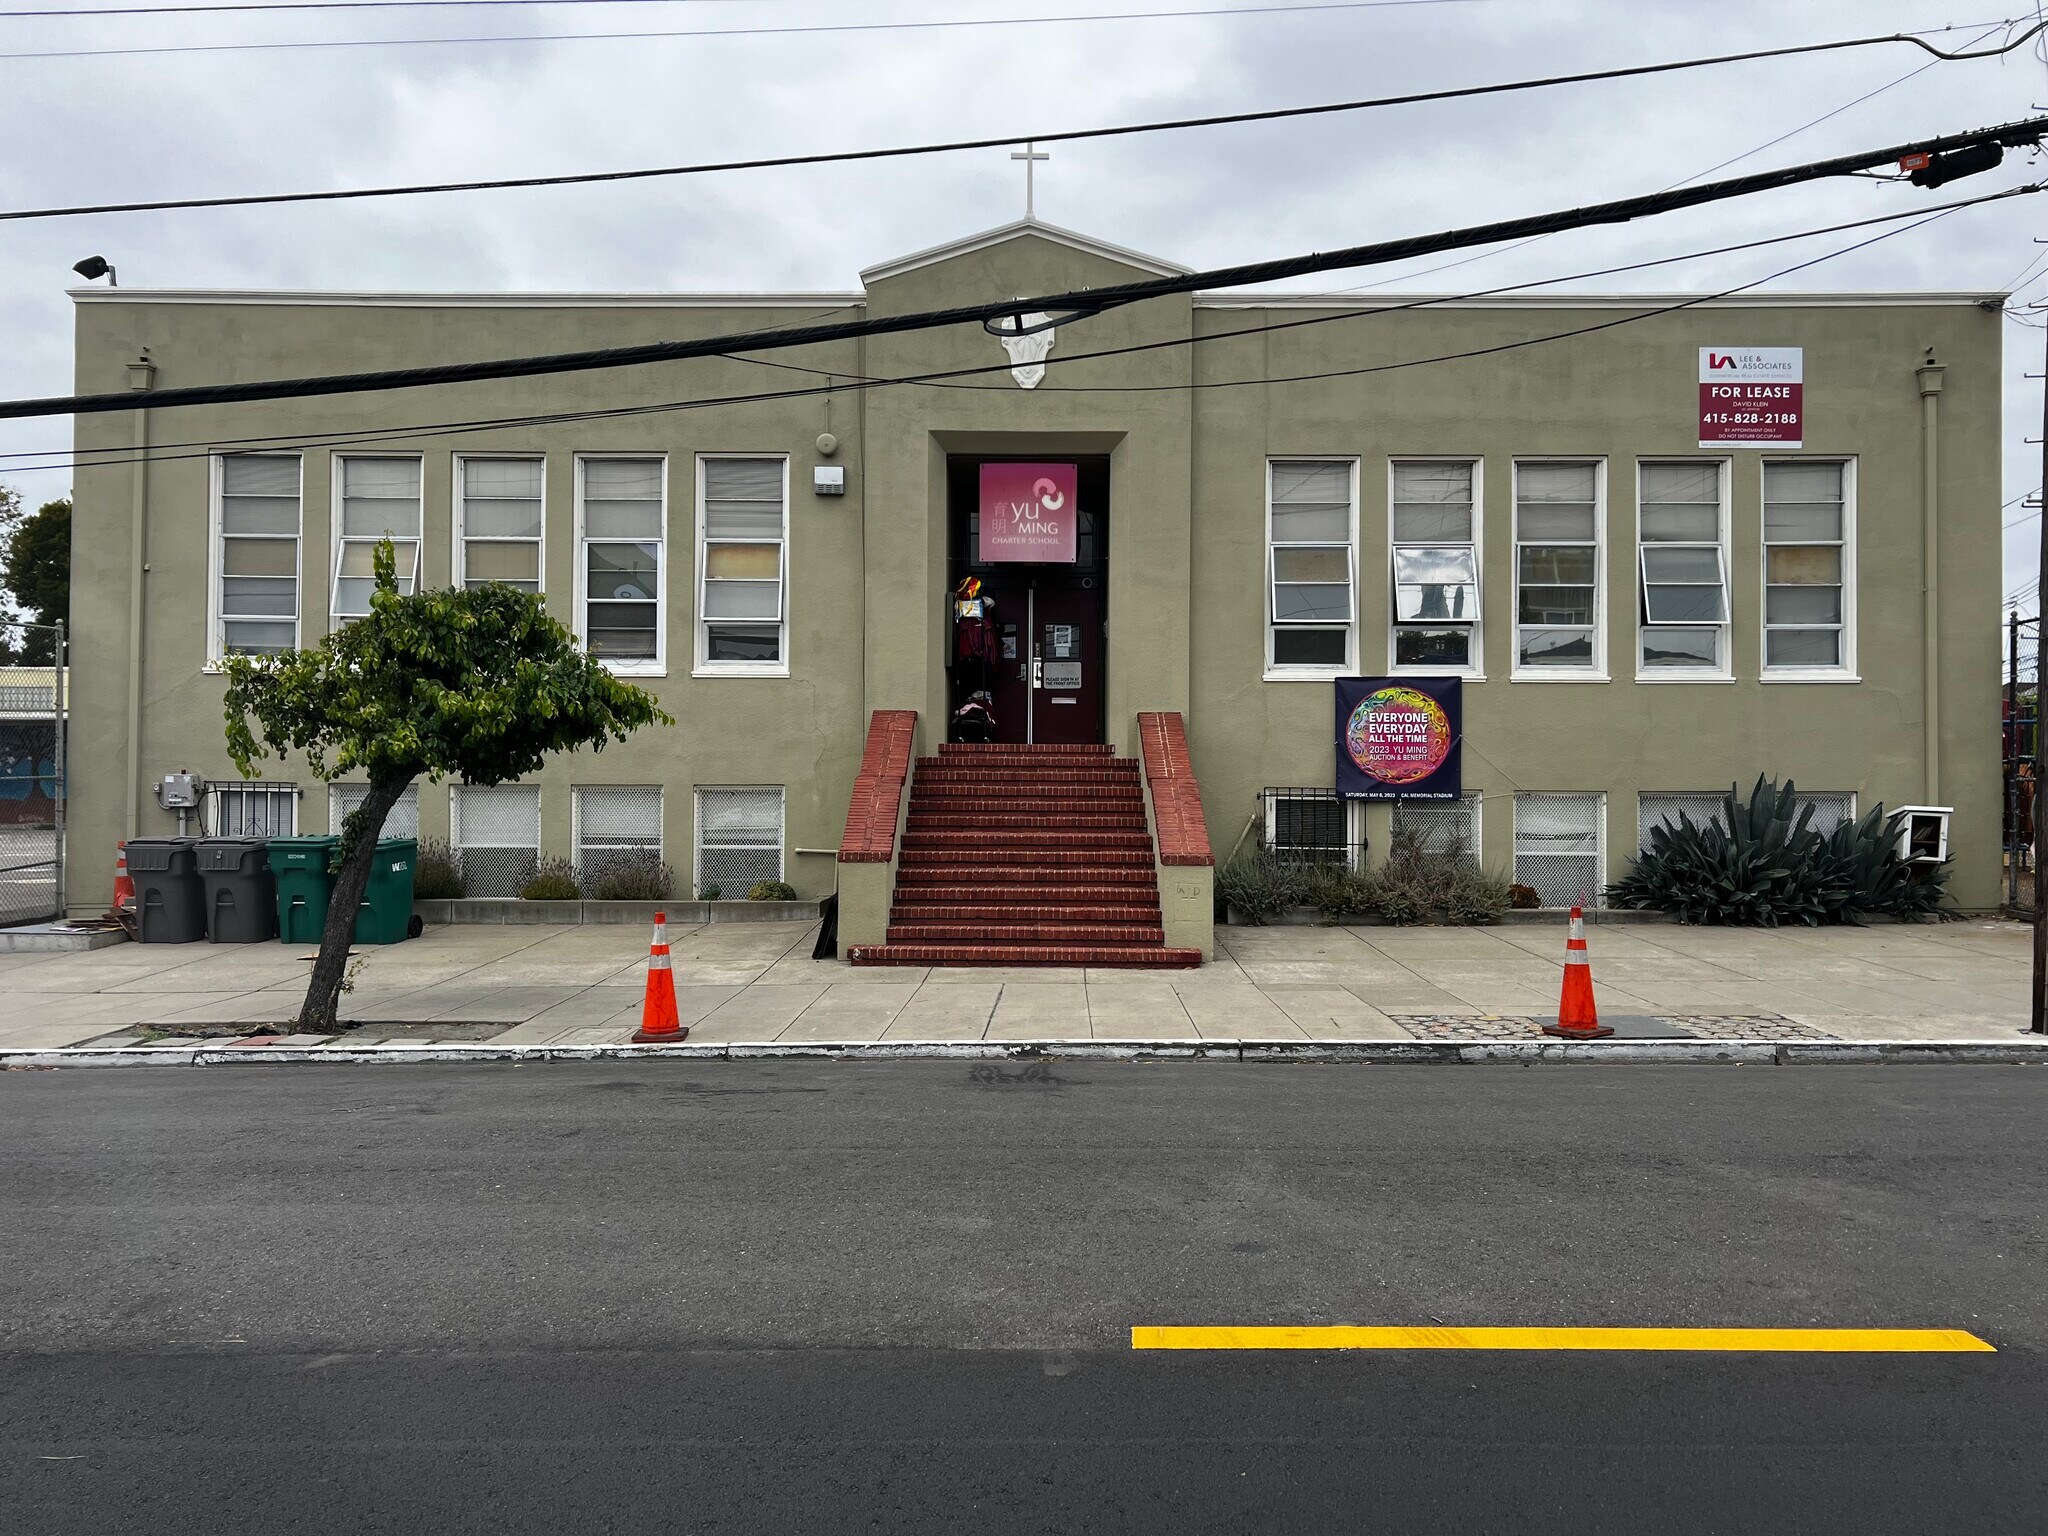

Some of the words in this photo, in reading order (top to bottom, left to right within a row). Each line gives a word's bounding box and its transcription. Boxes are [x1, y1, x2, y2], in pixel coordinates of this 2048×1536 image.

[1712, 387, 1741, 398] FOR
[1747, 387, 1790, 398] LEASE
[1703, 413, 1797, 424] 415-828-2188
[1018, 522, 1058, 535] MING
[1369, 712, 1428, 723] EVERYONE
[1369, 723, 1428, 734] EVERYDAY
[1368, 735, 1385, 743] ALL
[1386, 735, 1404, 743] THE
[1405, 735, 1428, 743] TIME
[1369, 746, 1390, 754] 2023
[1393, 746, 1404, 754] YU
[1406, 746, 1428, 754] MING
